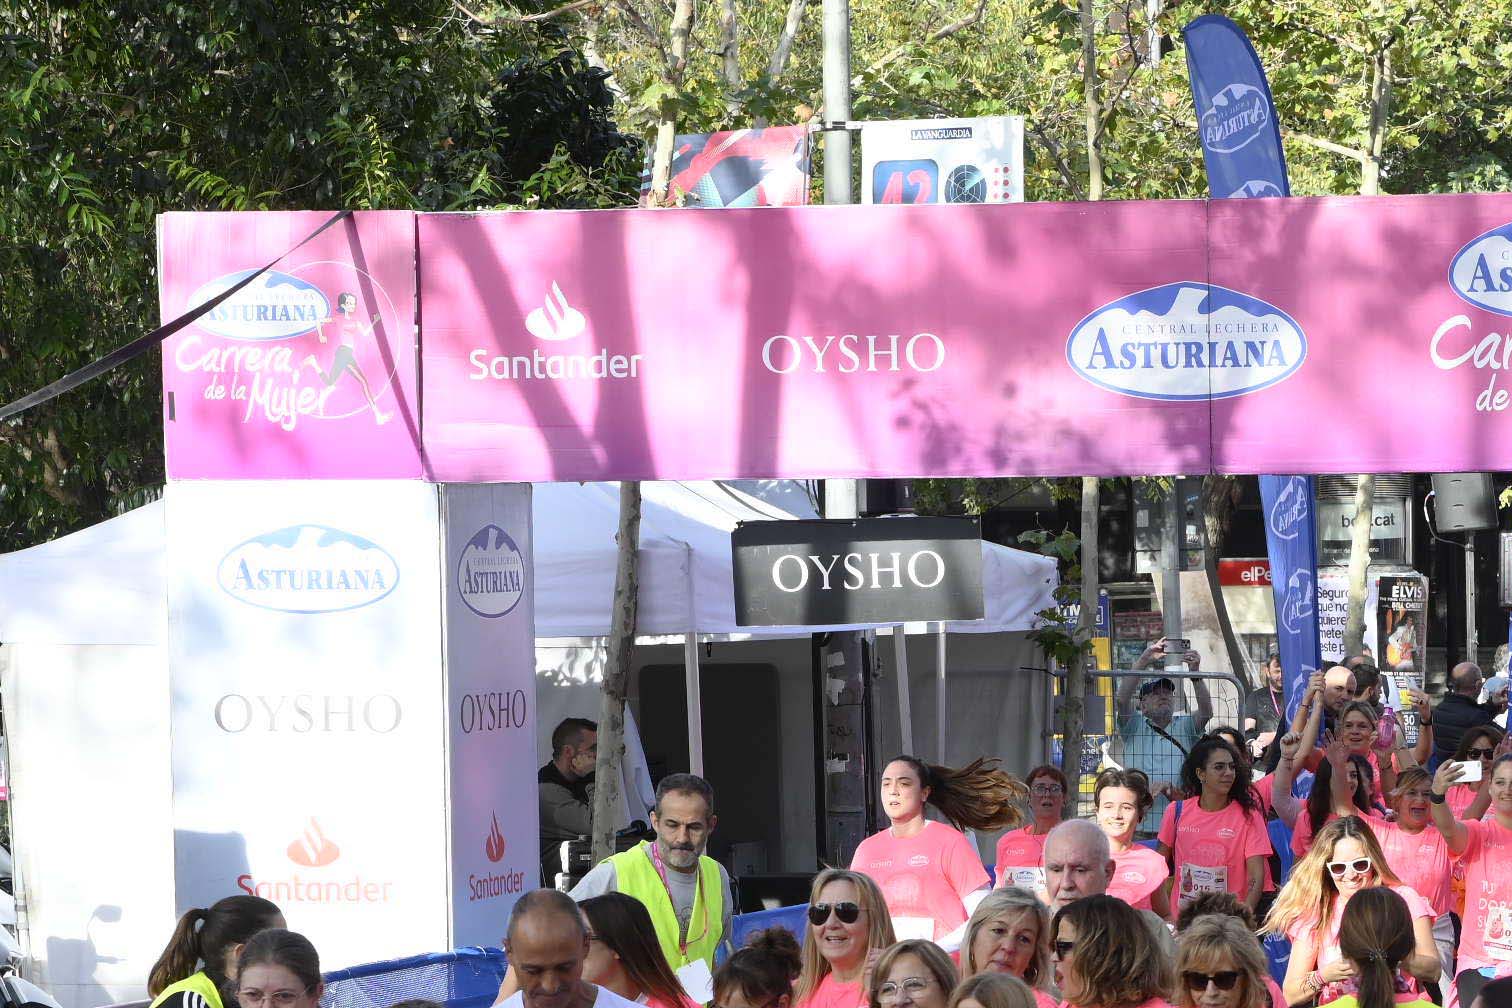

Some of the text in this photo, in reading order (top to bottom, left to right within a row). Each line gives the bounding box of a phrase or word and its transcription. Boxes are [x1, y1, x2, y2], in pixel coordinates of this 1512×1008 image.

[922, 128, 972, 139] VANGUARDIA
[1122, 322, 1280, 335] CENTRAL LECHERA
[176, 335, 293, 372] Carrera
[469, 347, 647, 380] Santander
[762, 333, 946, 374] OYSHO
[1086, 327, 1288, 370] ASTURIANA
[204, 372, 337, 431] de la Mujer
[1476, 374, 1510, 412] de
[233, 558, 387, 592] ASTURIANA
[463, 559, 521, 594] ASTURIANA
[772, 550, 946, 592] OYSHO
[1392, 586, 1422, 598] ELVIS
[215, 694, 403, 733] OYSHO
[461, 689, 526, 733] OYSHO
[1403, 715, 1415, 725] 30
[469, 868, 525, 901] Santander
